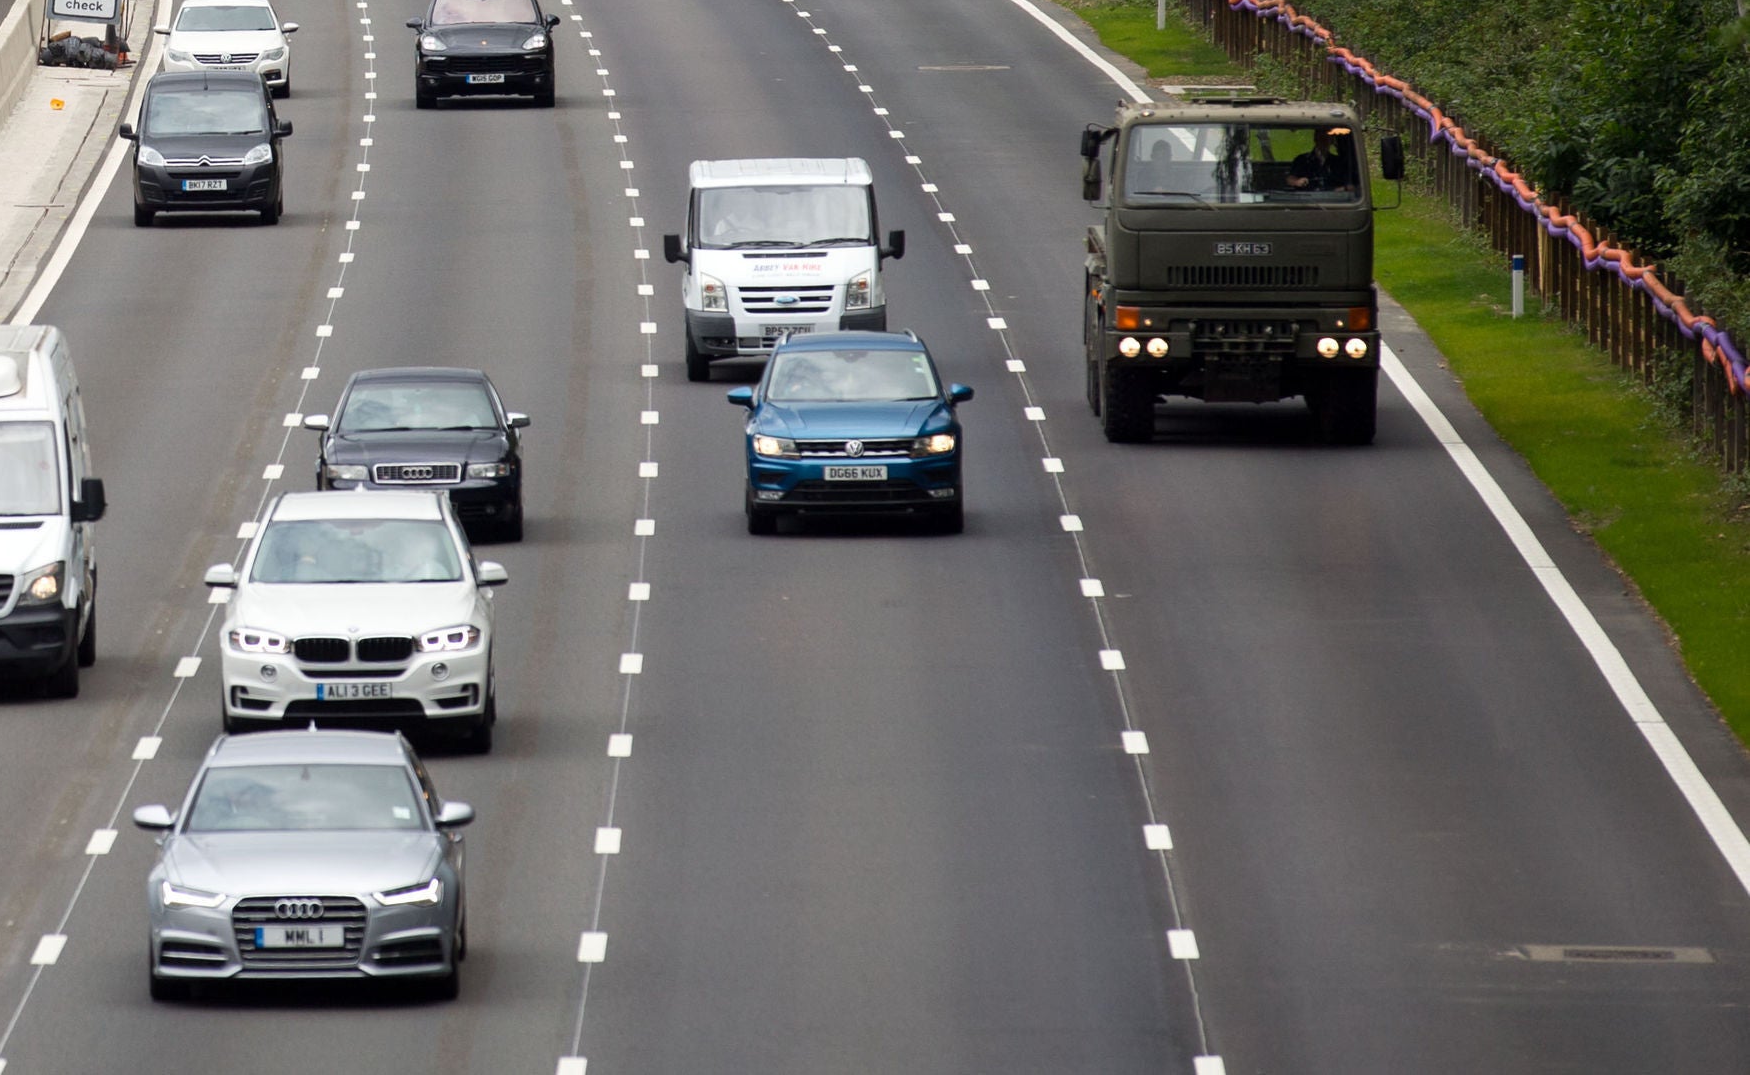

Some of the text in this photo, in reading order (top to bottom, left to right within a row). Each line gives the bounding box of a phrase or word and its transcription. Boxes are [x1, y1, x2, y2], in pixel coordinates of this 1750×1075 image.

[65, 0, 103, 11] check
[188, 180, 223, 189] BK17 RZT
[830, 468, 883, 478] DG66 KUX
[362, 684, 388, 697] GEE
